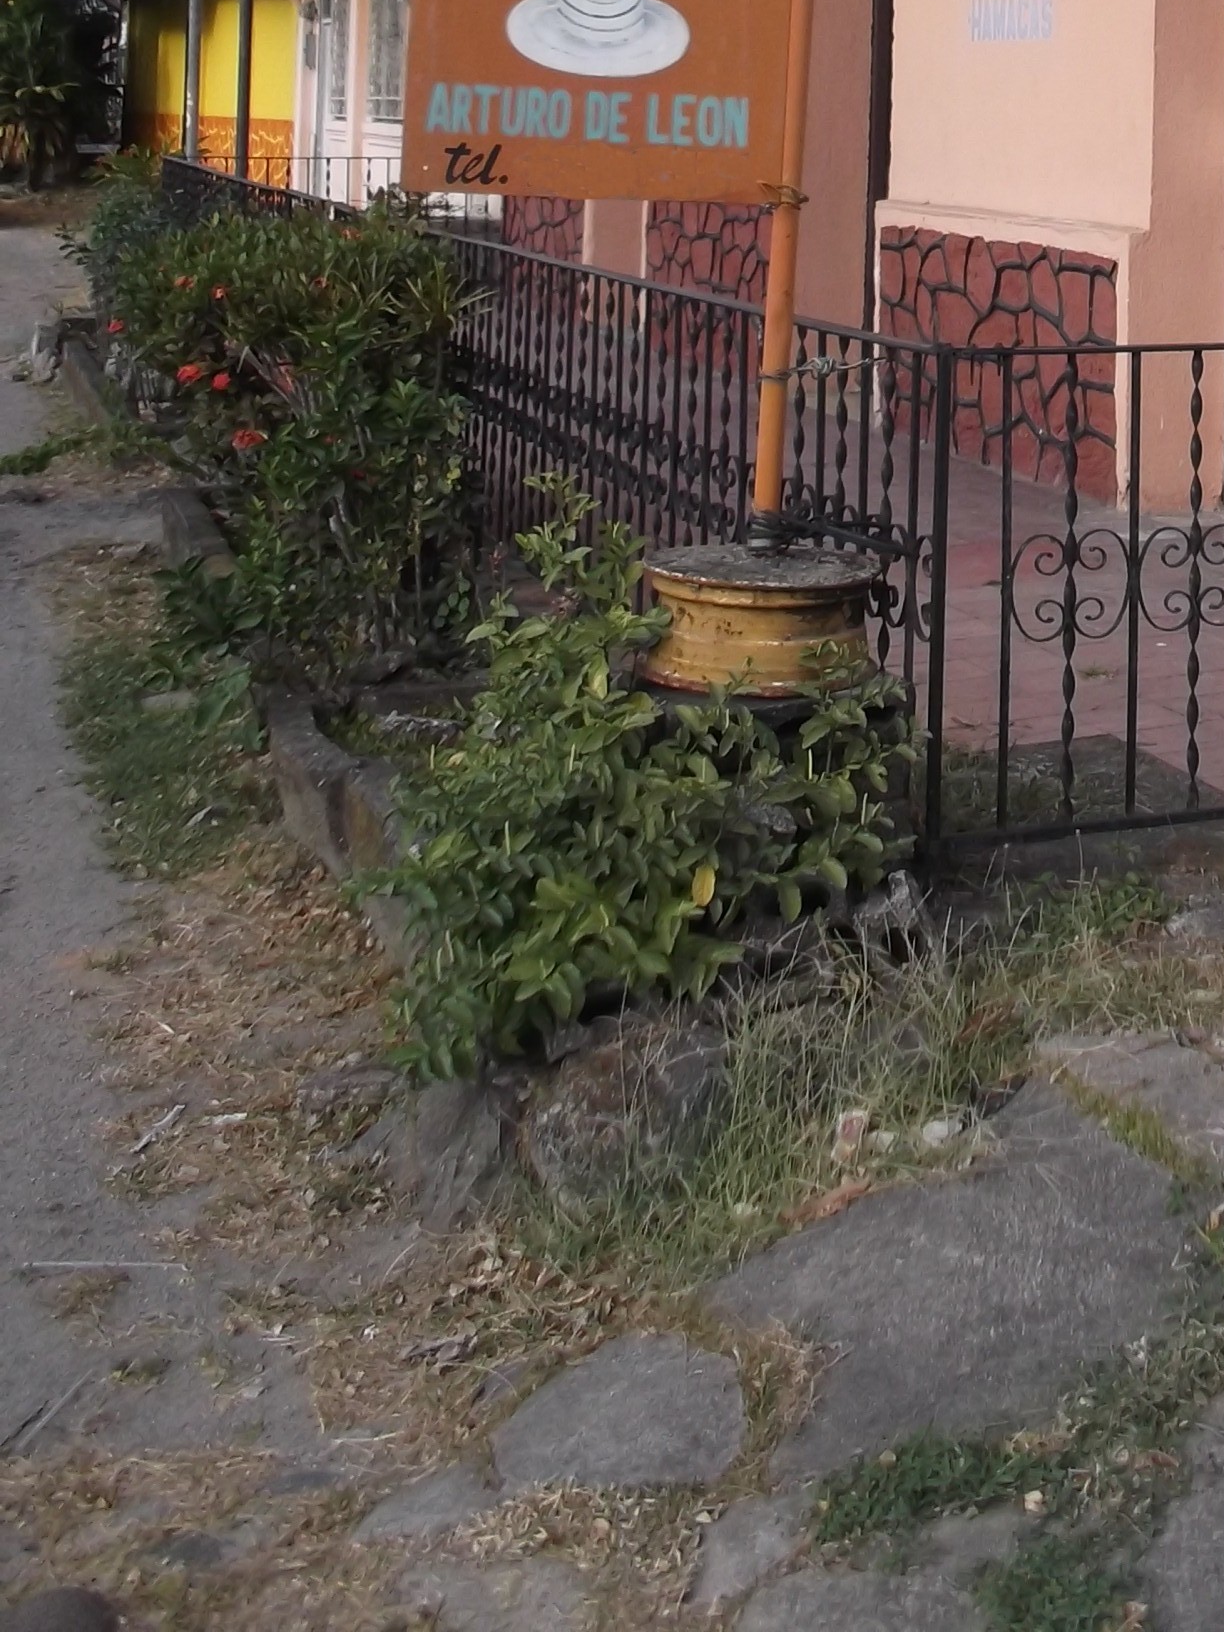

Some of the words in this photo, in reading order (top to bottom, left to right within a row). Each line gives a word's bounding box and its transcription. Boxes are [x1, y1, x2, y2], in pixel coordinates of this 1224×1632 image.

[426, 81, 573, 139] ARTURO
[584, 90, 632, 144] DE
[644, 92, 750, 148] LEON
[443, 141, 509, 186] tel.
